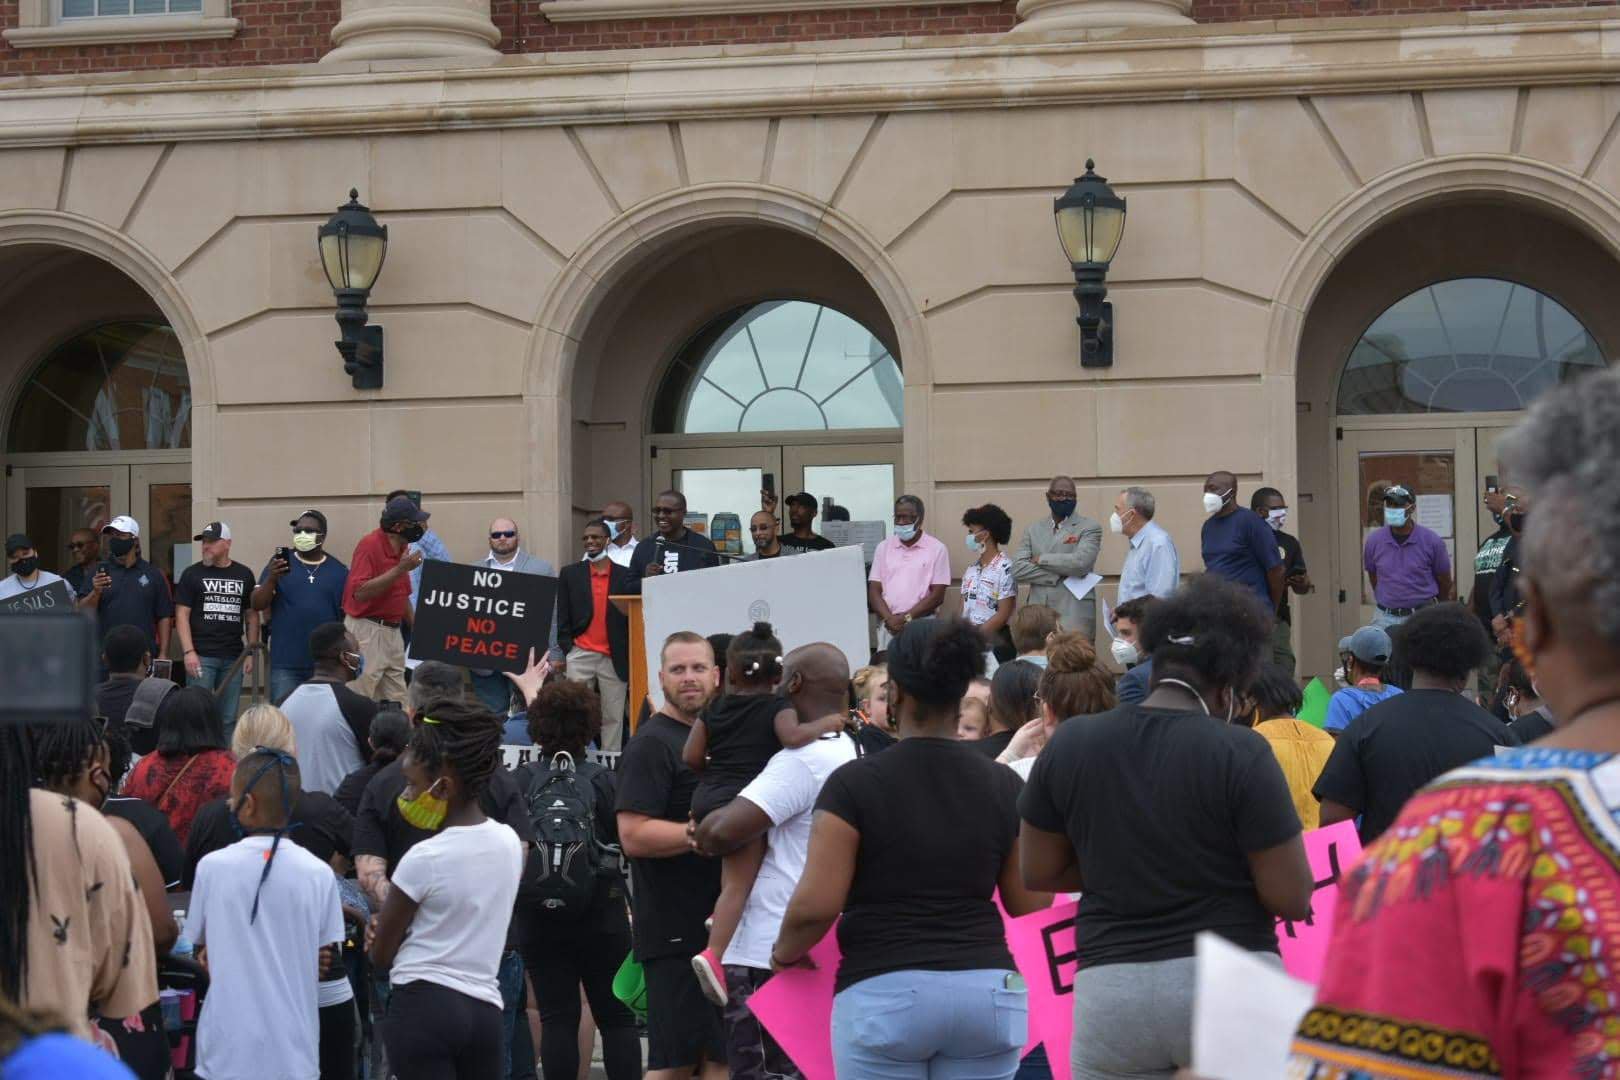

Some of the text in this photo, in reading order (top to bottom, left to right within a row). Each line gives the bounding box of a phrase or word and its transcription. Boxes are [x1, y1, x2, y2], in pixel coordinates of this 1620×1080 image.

[203, 580, 244, 595] WHEN
[473, 570, 502, 588] NO
[424, 590, 525, 617] JUSTICE
[204, 613, 218, 621] NOT
[466, 617, 496, 635] NO
[445, 635, 518, 659] PEACE
